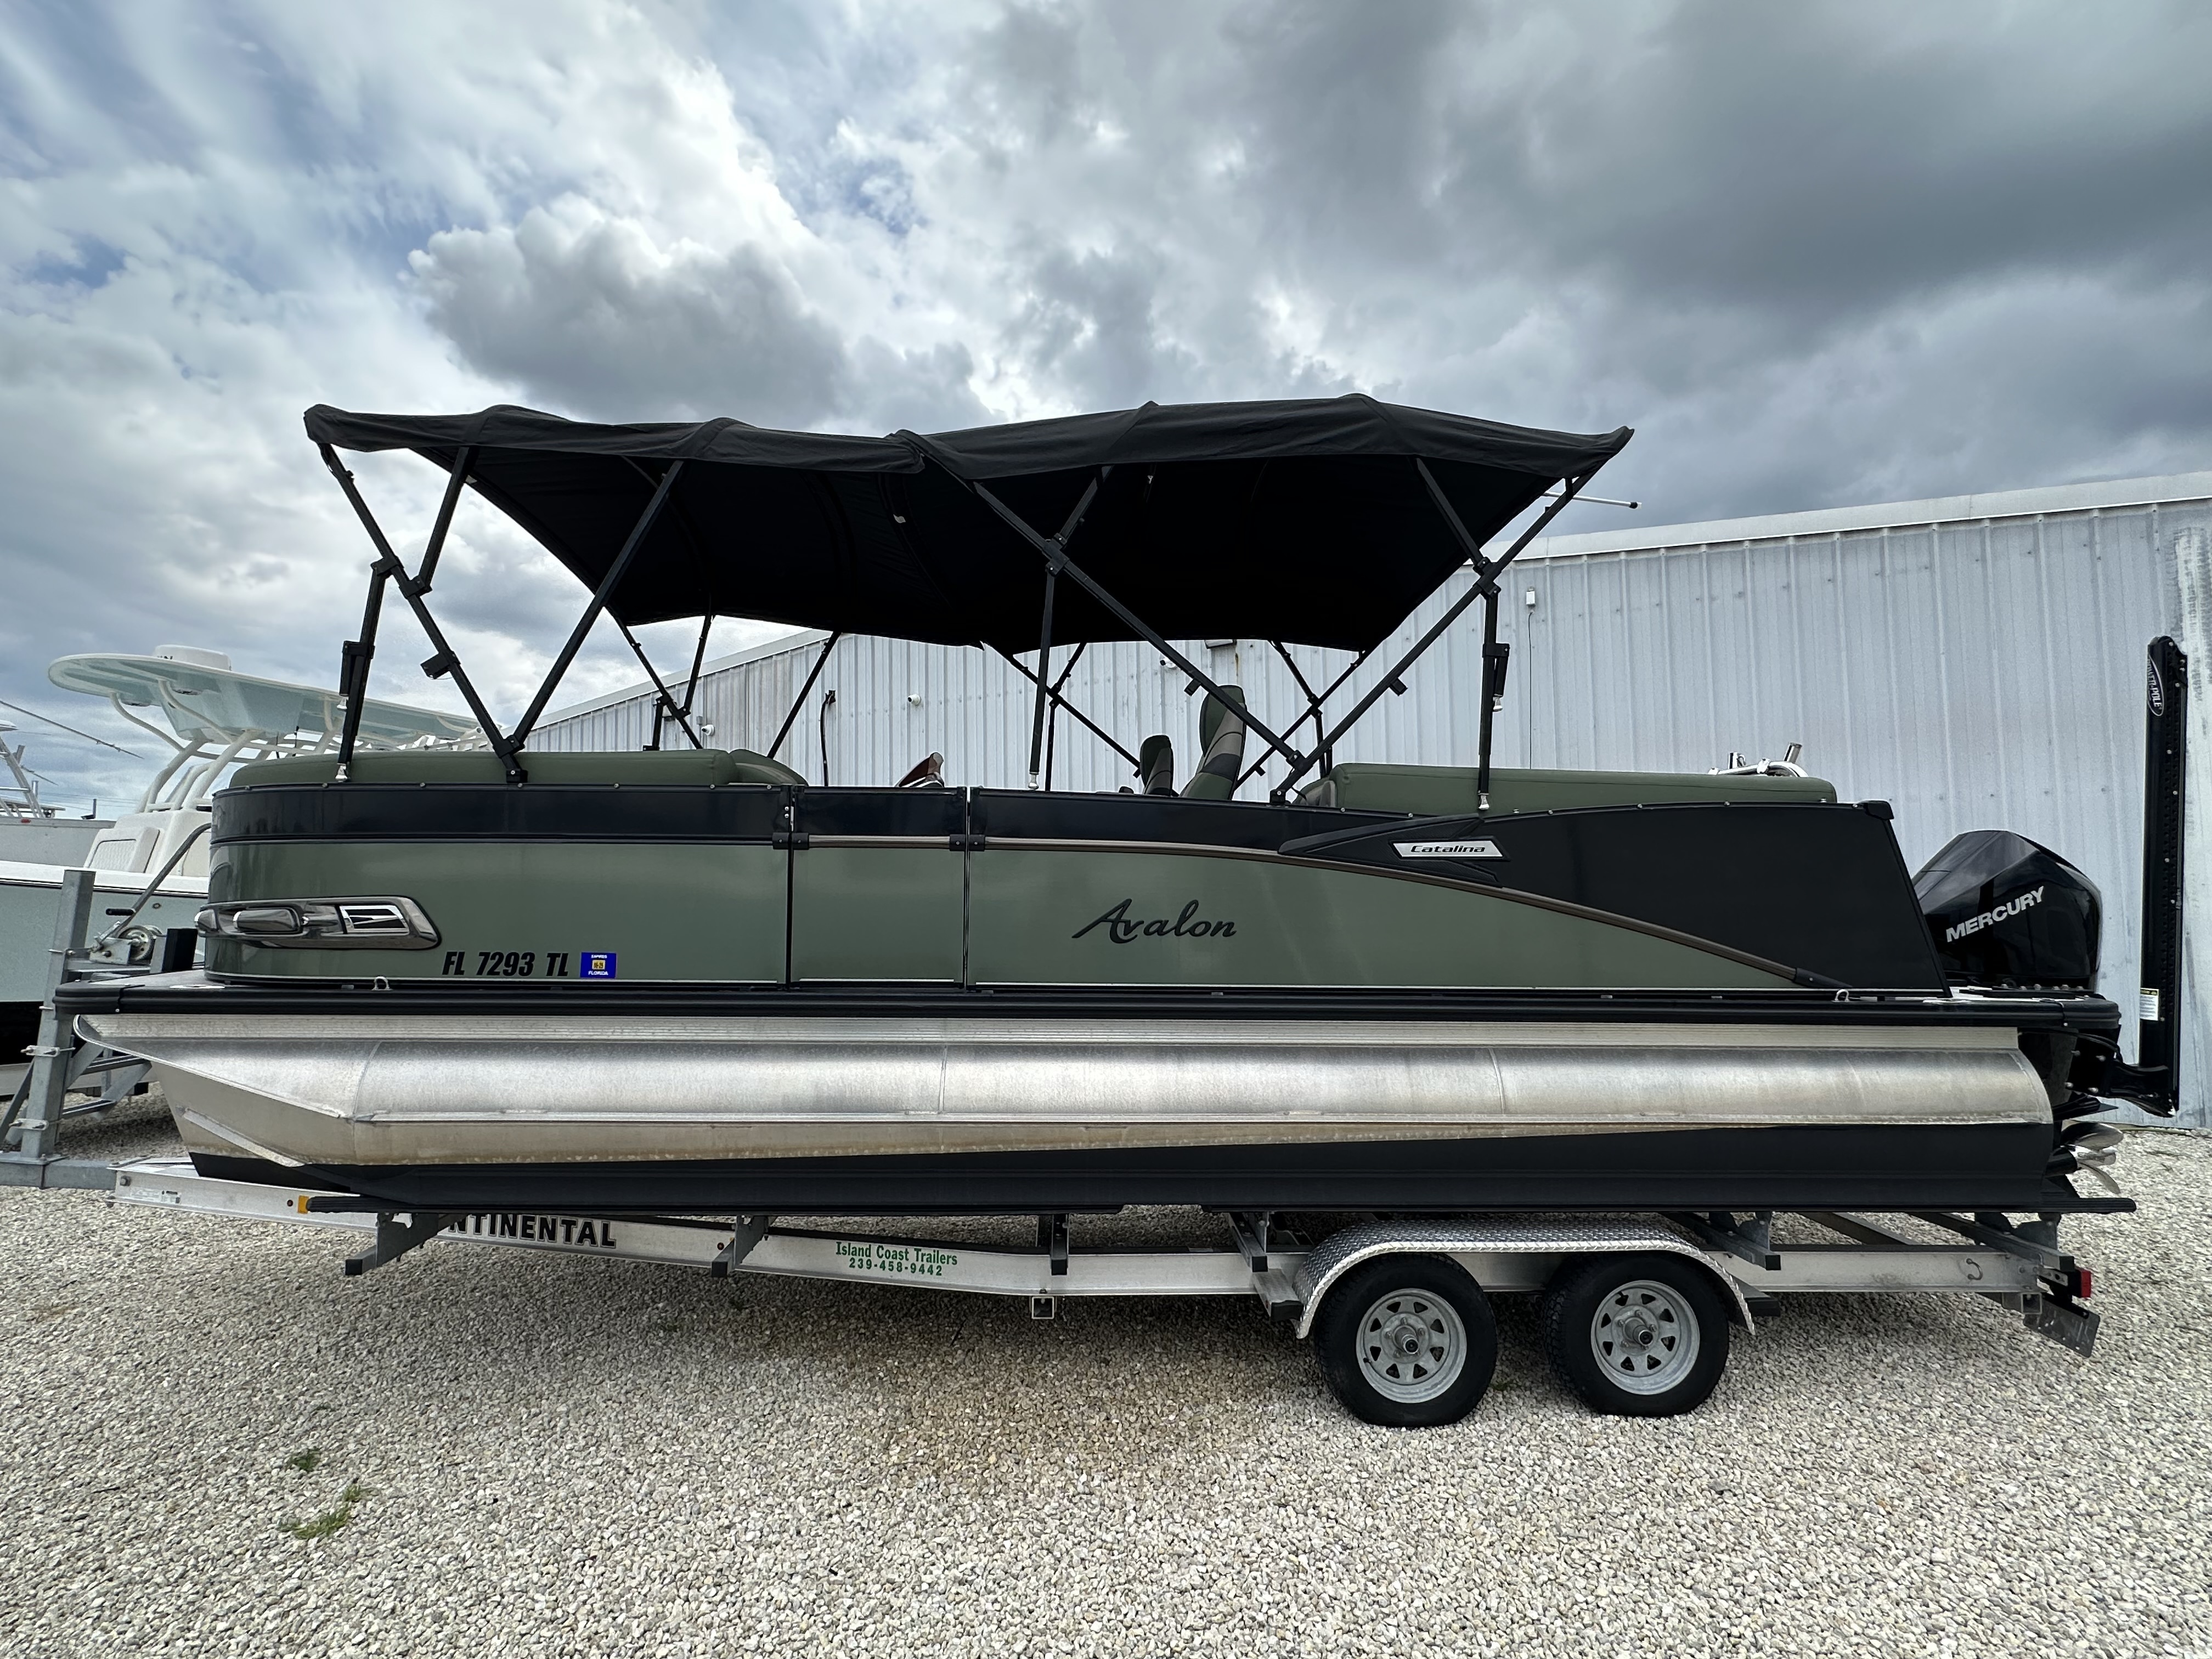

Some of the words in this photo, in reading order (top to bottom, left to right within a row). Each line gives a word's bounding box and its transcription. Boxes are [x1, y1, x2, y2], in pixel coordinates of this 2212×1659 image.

[1071, 898, 1238, 944] Avalon
[1945, 885, 2045, 943] MERCURY
[442, 951, 465, 975] FL
[476, 951, 535, 977] 7293
[546, 952, 569, 977] TL
[836, 1242, 872, 1258] Island
[876, 1245, 910, 1261] Coast
[913, 1248, 958, 1266] Trailers
[849, 1257, 943, 1276] 239-458-9442
